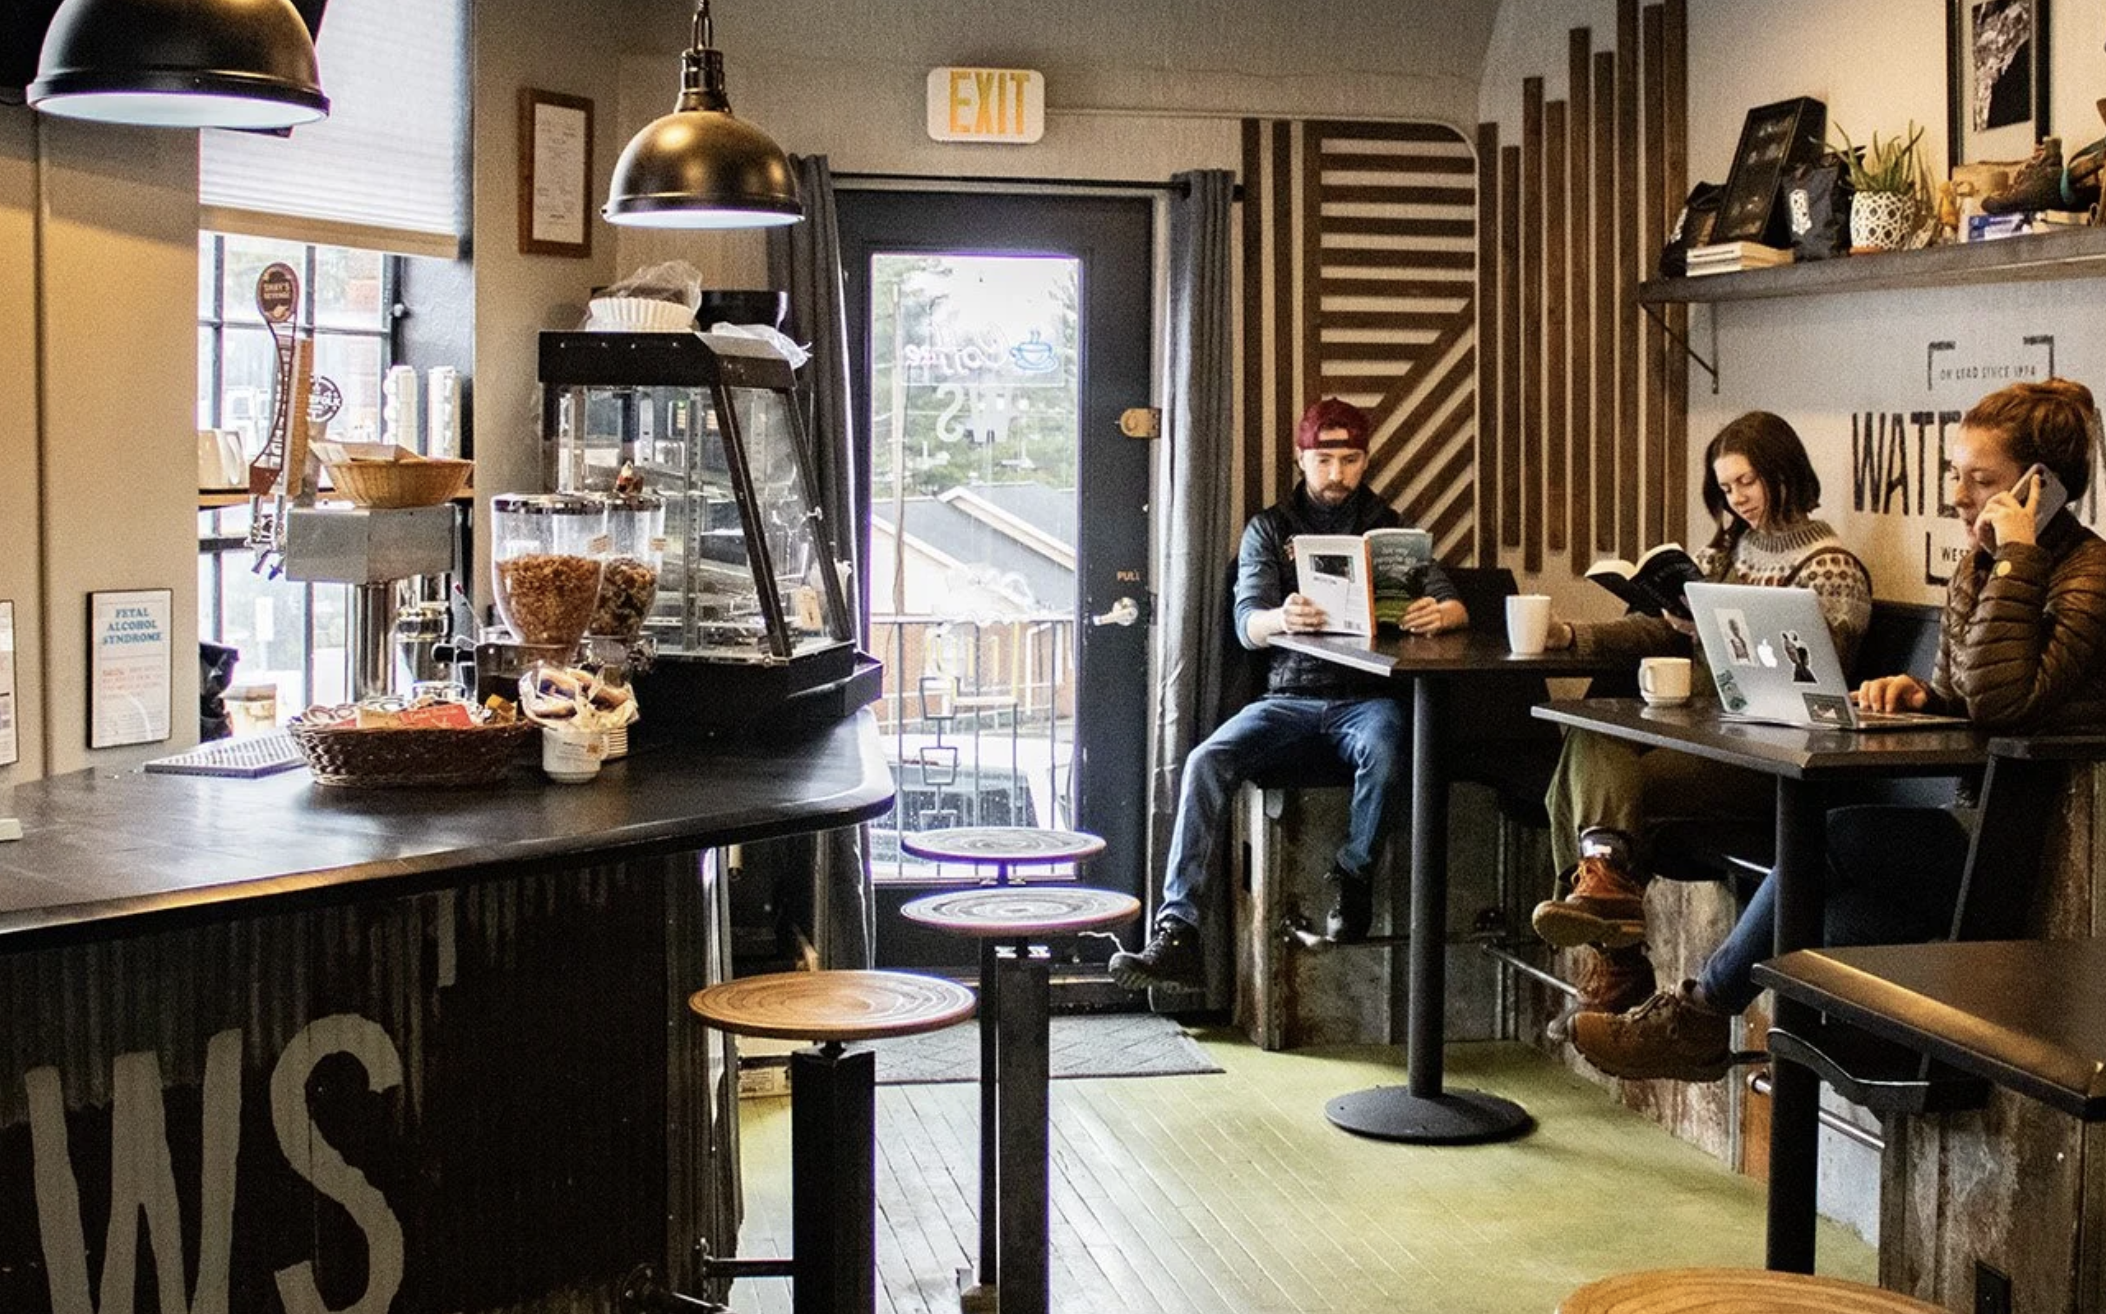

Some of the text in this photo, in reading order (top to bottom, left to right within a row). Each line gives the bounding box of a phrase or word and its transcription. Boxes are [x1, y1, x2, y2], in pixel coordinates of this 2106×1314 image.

[949, 70, 1031, 135] EXIT
[1852, 411, 1963, 518] WATE
[1116, 570, 1140, 581] PULL
[115, 608, 149, 619] FETAL
[107, 620, 157, 631] ALCOHOL
[103, 632, 161, 644] SYNDROME
[23, 1012, 405, 1314] WS
